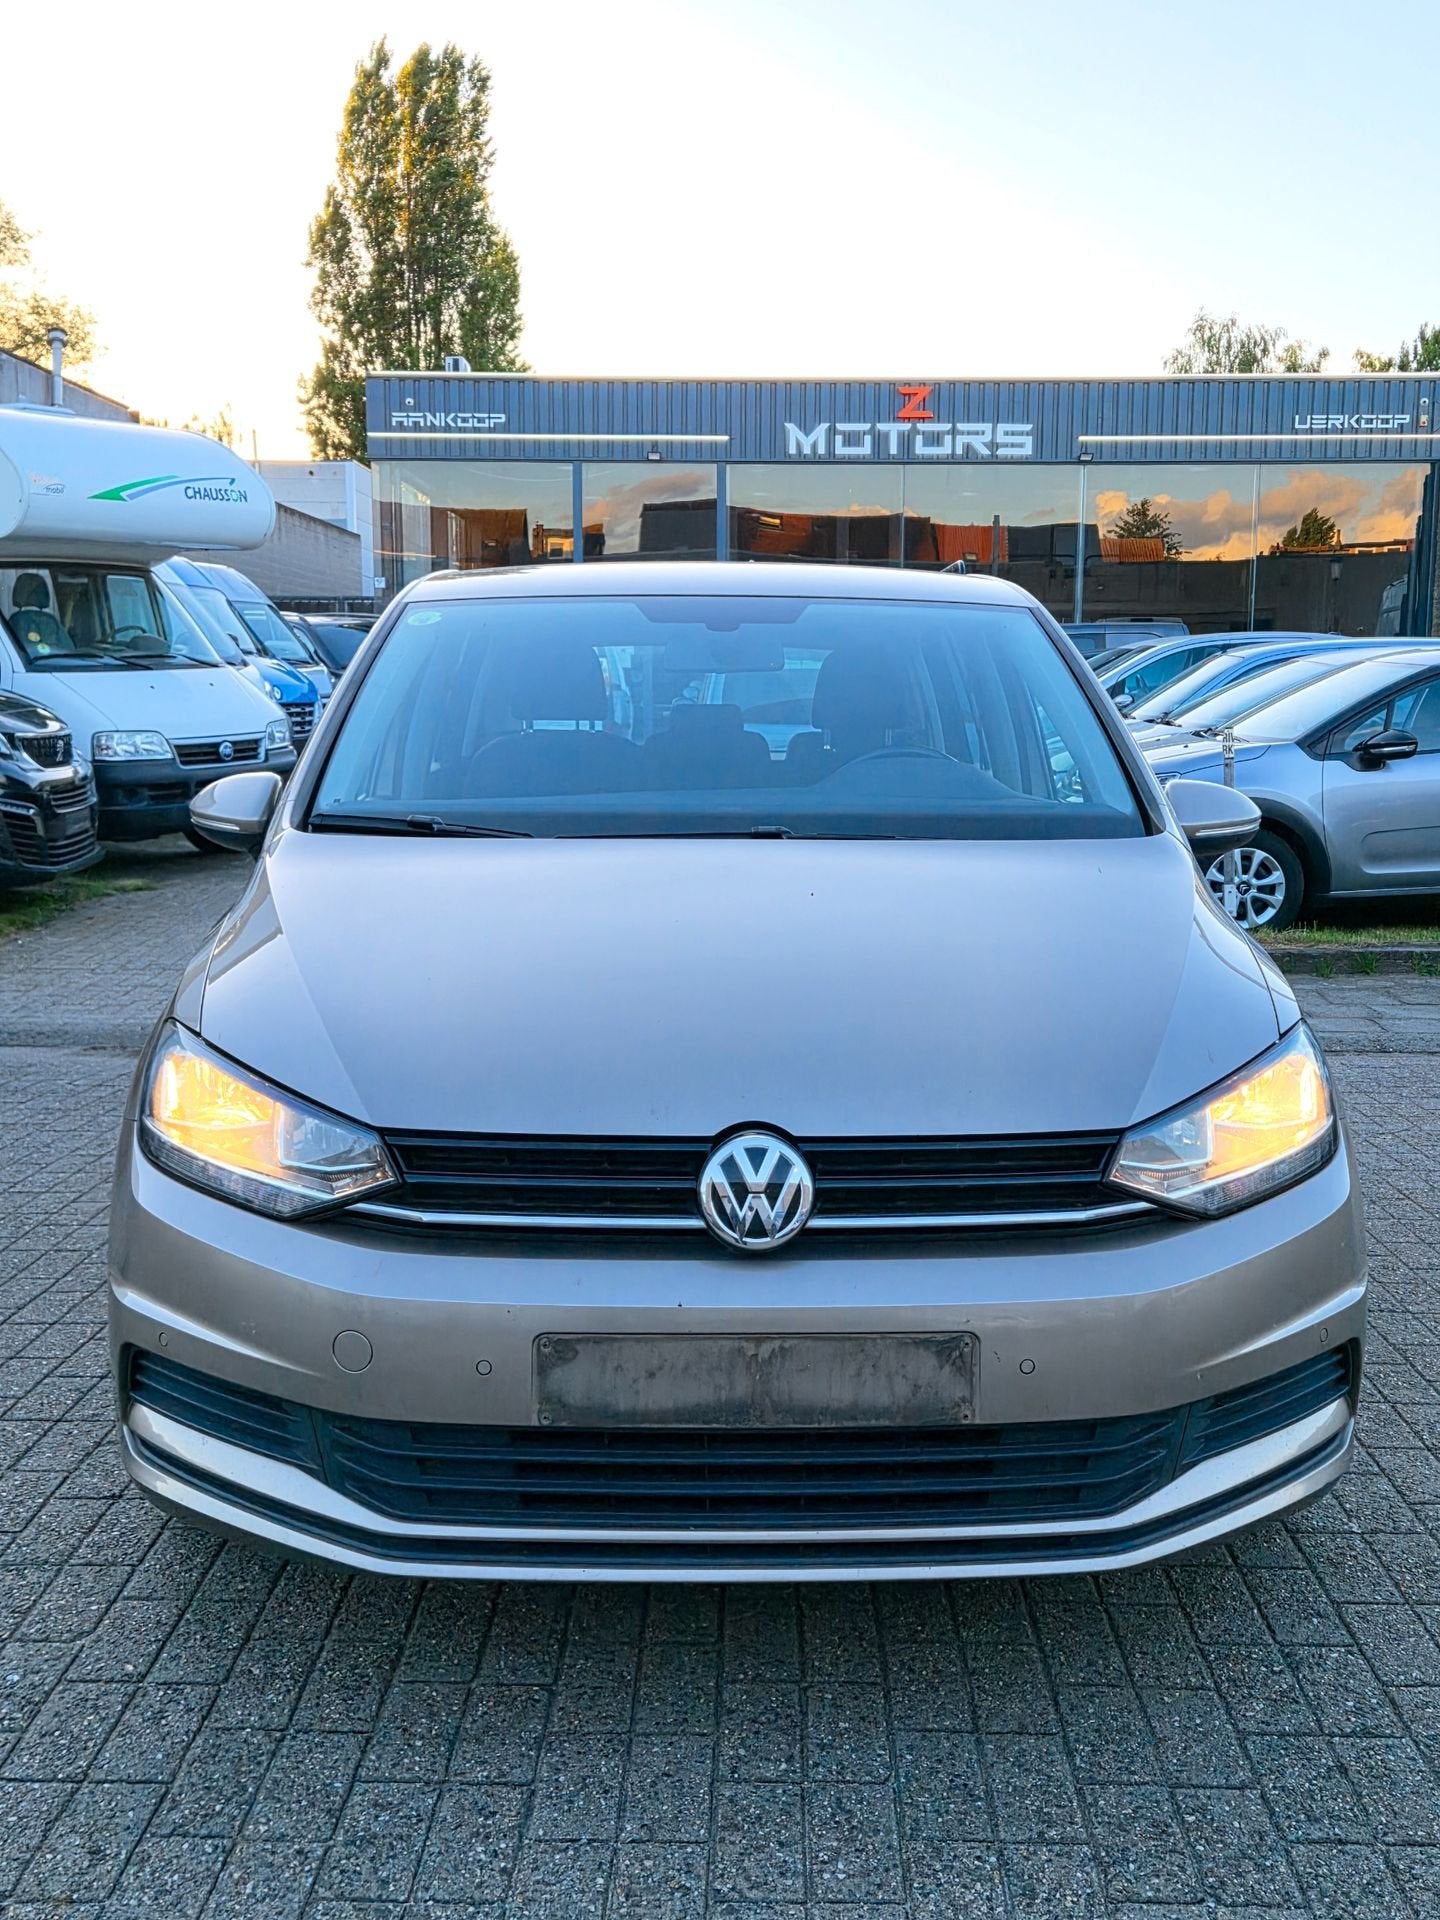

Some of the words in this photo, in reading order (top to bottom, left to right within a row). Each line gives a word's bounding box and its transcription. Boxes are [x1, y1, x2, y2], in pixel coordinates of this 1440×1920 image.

[896, 385, 934, 420] Z
[391, 412, 506, 428] AANKOOP
[784, 422, 1034, 456] MOTORS
[184, 485, 248, 503] CHAUSSON
